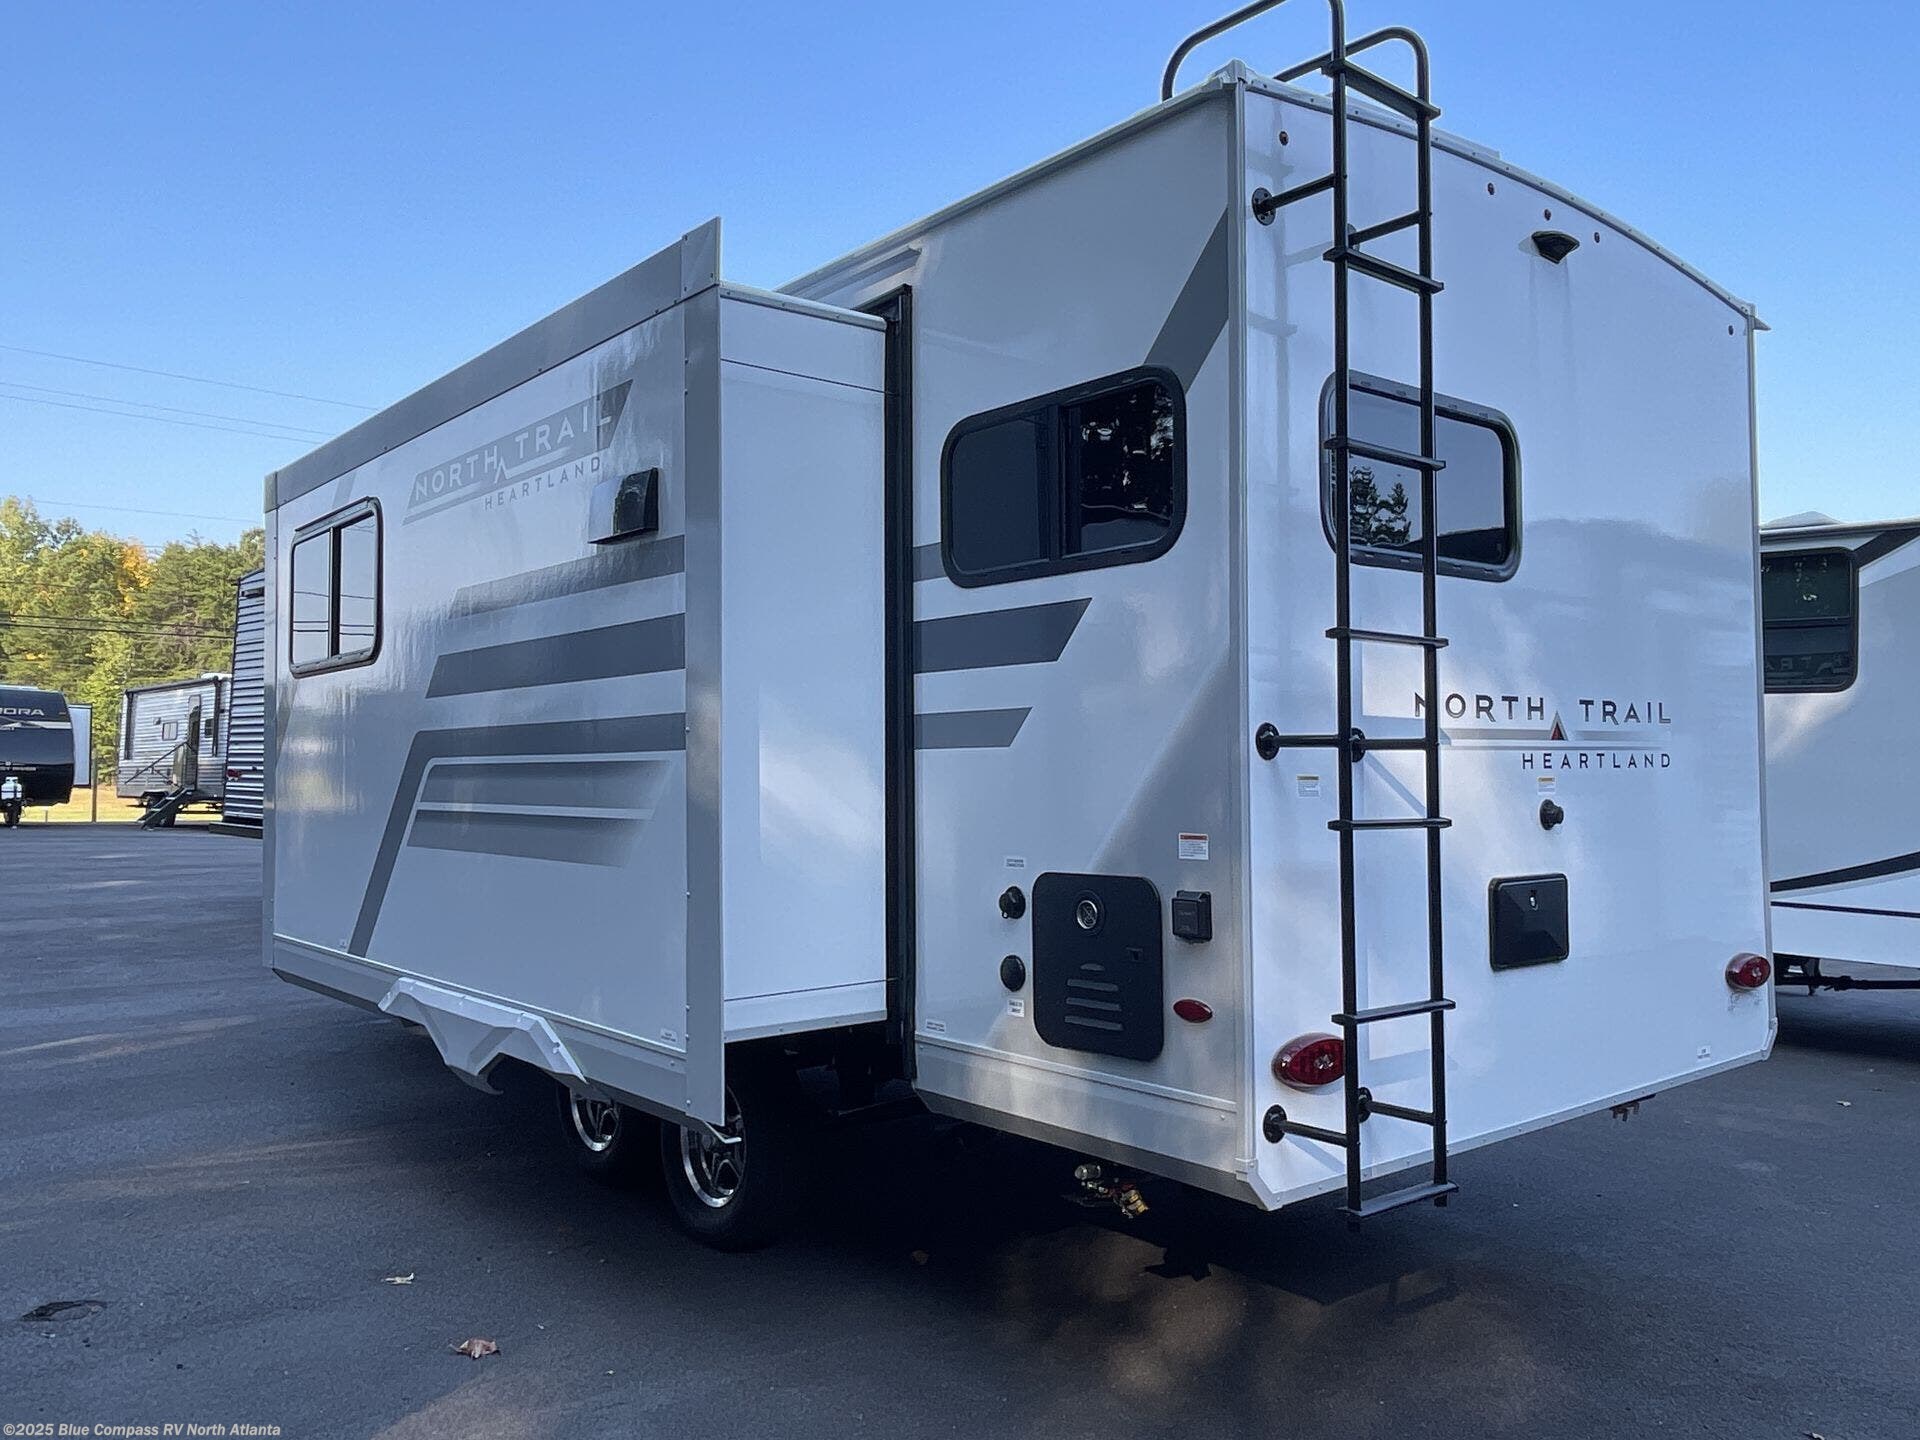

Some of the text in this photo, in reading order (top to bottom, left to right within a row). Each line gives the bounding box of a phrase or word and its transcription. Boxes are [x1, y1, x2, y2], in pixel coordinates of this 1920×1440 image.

[414, 403, 612, 500] NORTH TRAIL
[484, 456, 600, 511] HEARTLAND
[0, 707, 45, 716] ORA
[1579, 699, 1672, 725] TRAIL
[1522, 753, 1672, 770] HEARTLAND
